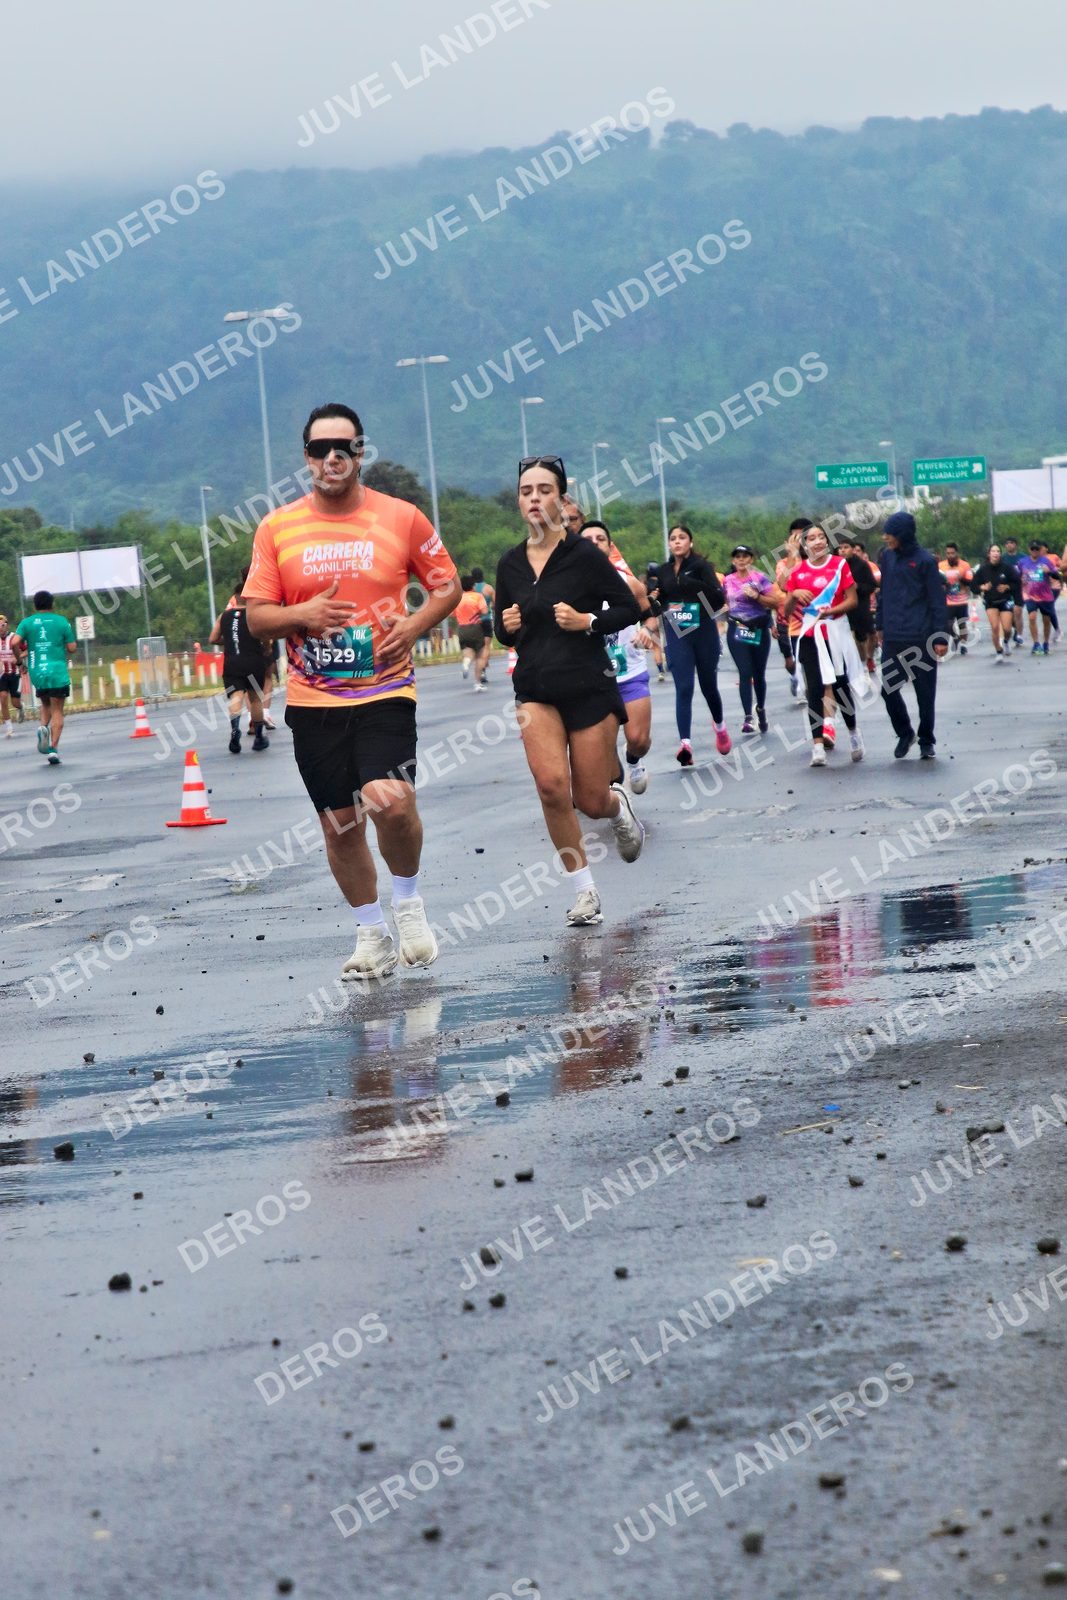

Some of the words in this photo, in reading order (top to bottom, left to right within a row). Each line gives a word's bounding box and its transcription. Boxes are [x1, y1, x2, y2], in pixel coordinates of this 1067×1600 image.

[956, 460, 969, 468] SUR
[840, 466, 877, 475] ZAPOPAN
[929, 470, 969, 480] GUADALUPE
[860, 475, 887, 483] EVENTOS
[303, 540, 374, 564] CARRERA
[303, 560, 358, 575] OMNILIFE
[672, 612, 693, 620] 1660
[352, 629, 367, 640] 10K
[313, 647, 355, 663] 1529
